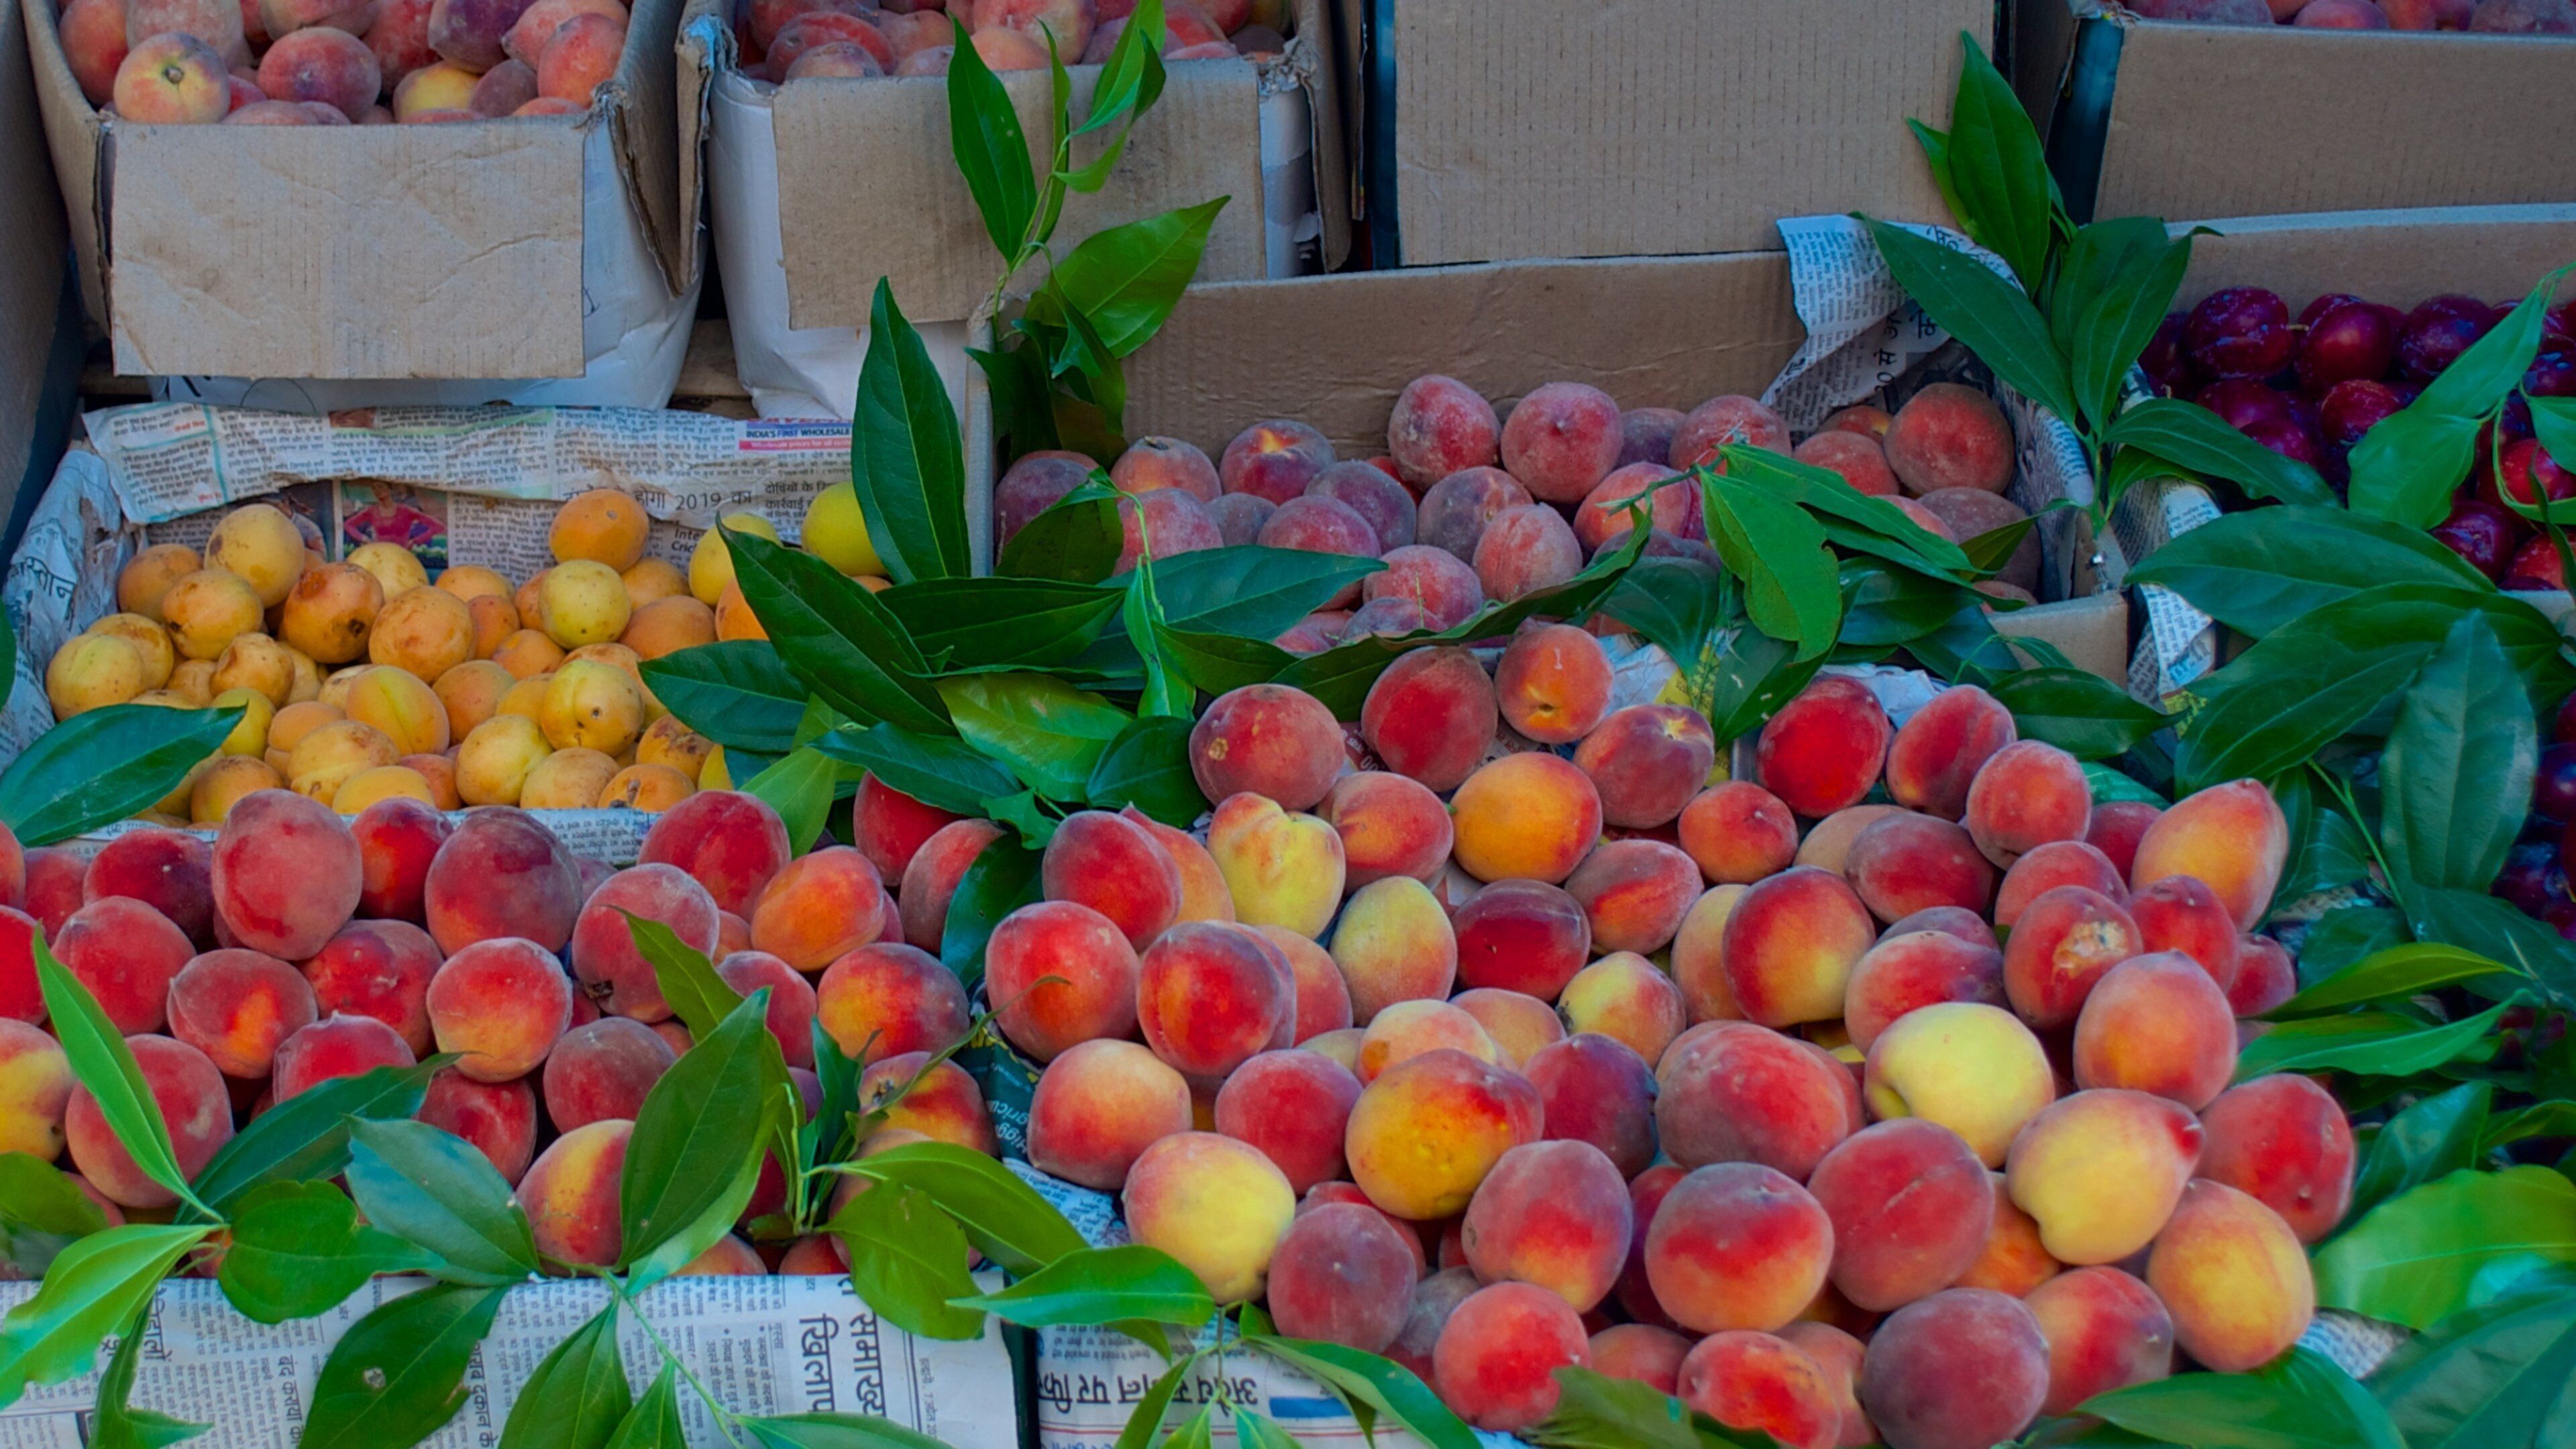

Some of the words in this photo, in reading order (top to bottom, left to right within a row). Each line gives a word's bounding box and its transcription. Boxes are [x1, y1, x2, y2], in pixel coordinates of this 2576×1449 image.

[747, 430, 775, 438] INDIA'S
[802, 480, 813, 492] के
[675, 492, 722, 511] 2019
[765, 496, 804, 510] कार्रवाई
[675, 529, 702, 541] Inte
[768, 1322, 784, 1350] गुस्सा
[278, 1354, 297, 1377] बंद
[1077, 1375, 1110, 1404] पर
[282, 1381, 302, 1421] कराया
[469, 1383, 492, 1428] दुकान
[478, 1430, 498, 1448] के
